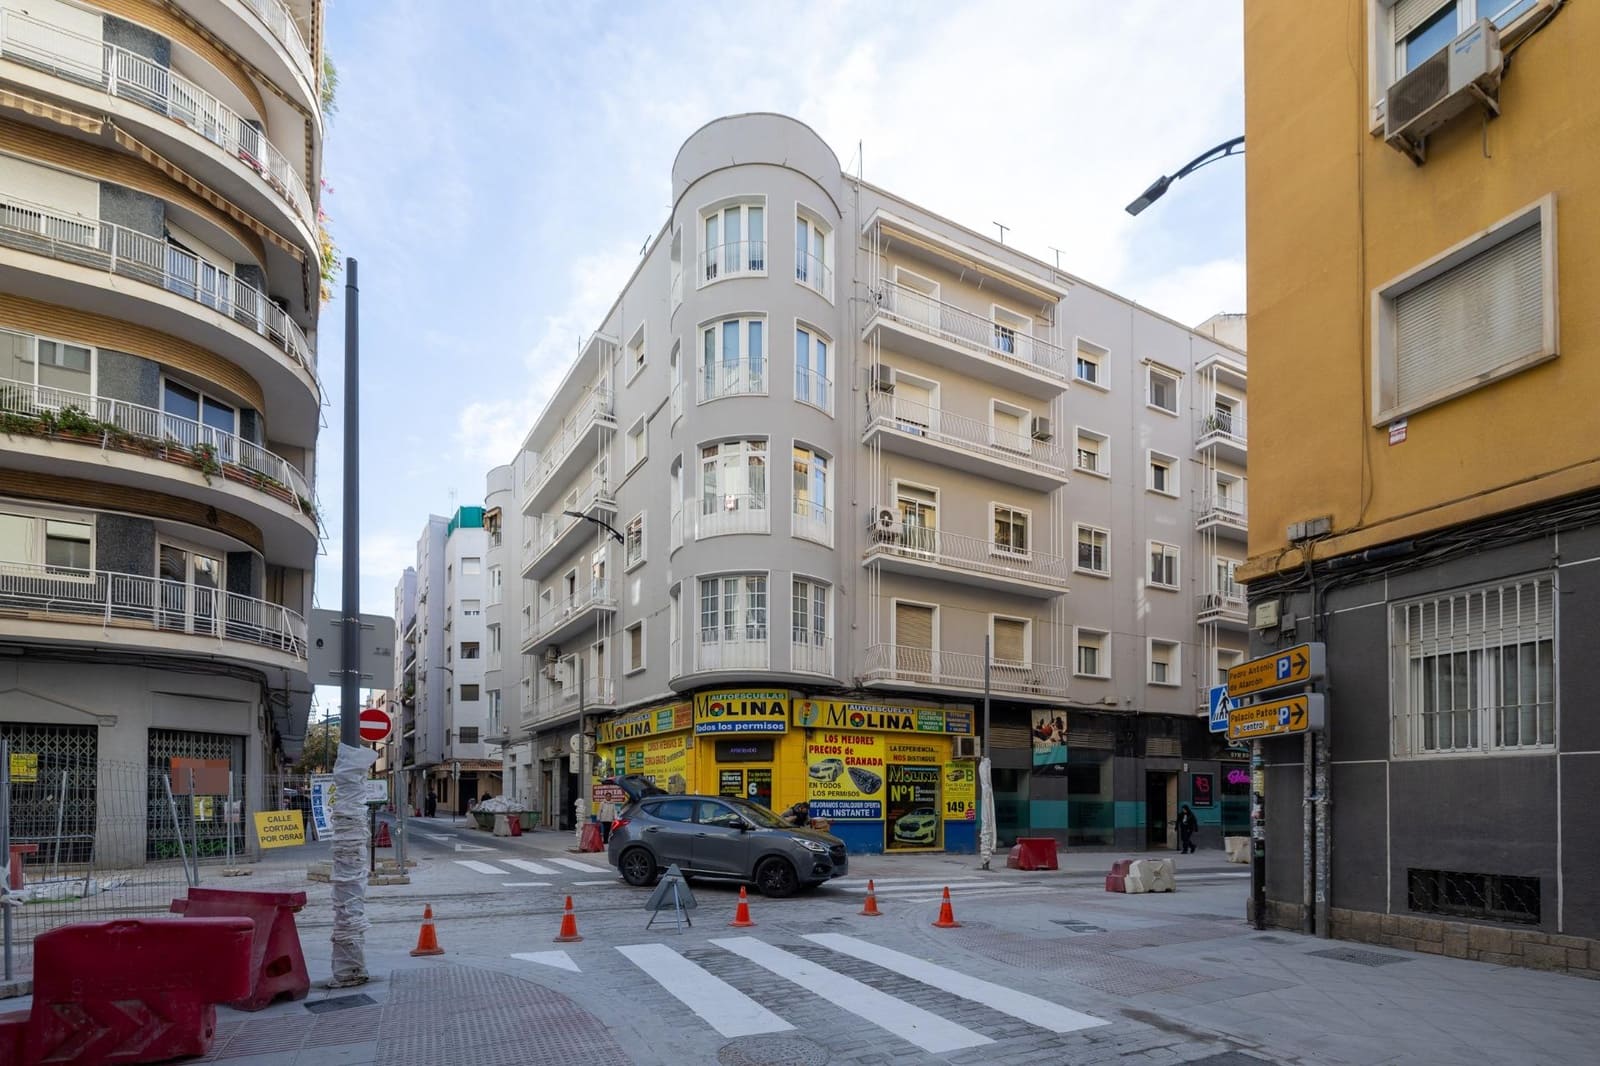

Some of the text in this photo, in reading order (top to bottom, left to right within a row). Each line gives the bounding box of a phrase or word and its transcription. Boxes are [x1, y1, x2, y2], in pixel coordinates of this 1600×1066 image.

[1248, 662, 1274, 675] Antonio
[1278, 658, 1290, 680] P
[711, 693, 785, 701] AUTOESCUELAS
[848, 704, 914, 715] AUTOESCUELAS
[1230, 706, 1278, 723] Palacio Patos
[1278, 706, 1289, 726] P
[718, 722, 733, 731] los
[735, 721, 785, 732] permisos
[824, 733, 875, 746] LOS MEJORES
[809, 745, 855, 755] PRECIOS de
[845, 757, 884, 767] GRANADA
[965, 769, 974, 782] B
[748, 783, 757, 795] 6
[810, 801, 839, 809] MEJORAMOS
[839, 801, 864, 809] CUALQUIER
[946, 801, 965, 813] 149
[821, 809, 832, 817] AL
[833, 809, 870, 817] INSTANTE
[263, 824, 299, 832] CORTADA
[261, 832, 304, 843] POR OBRAS
